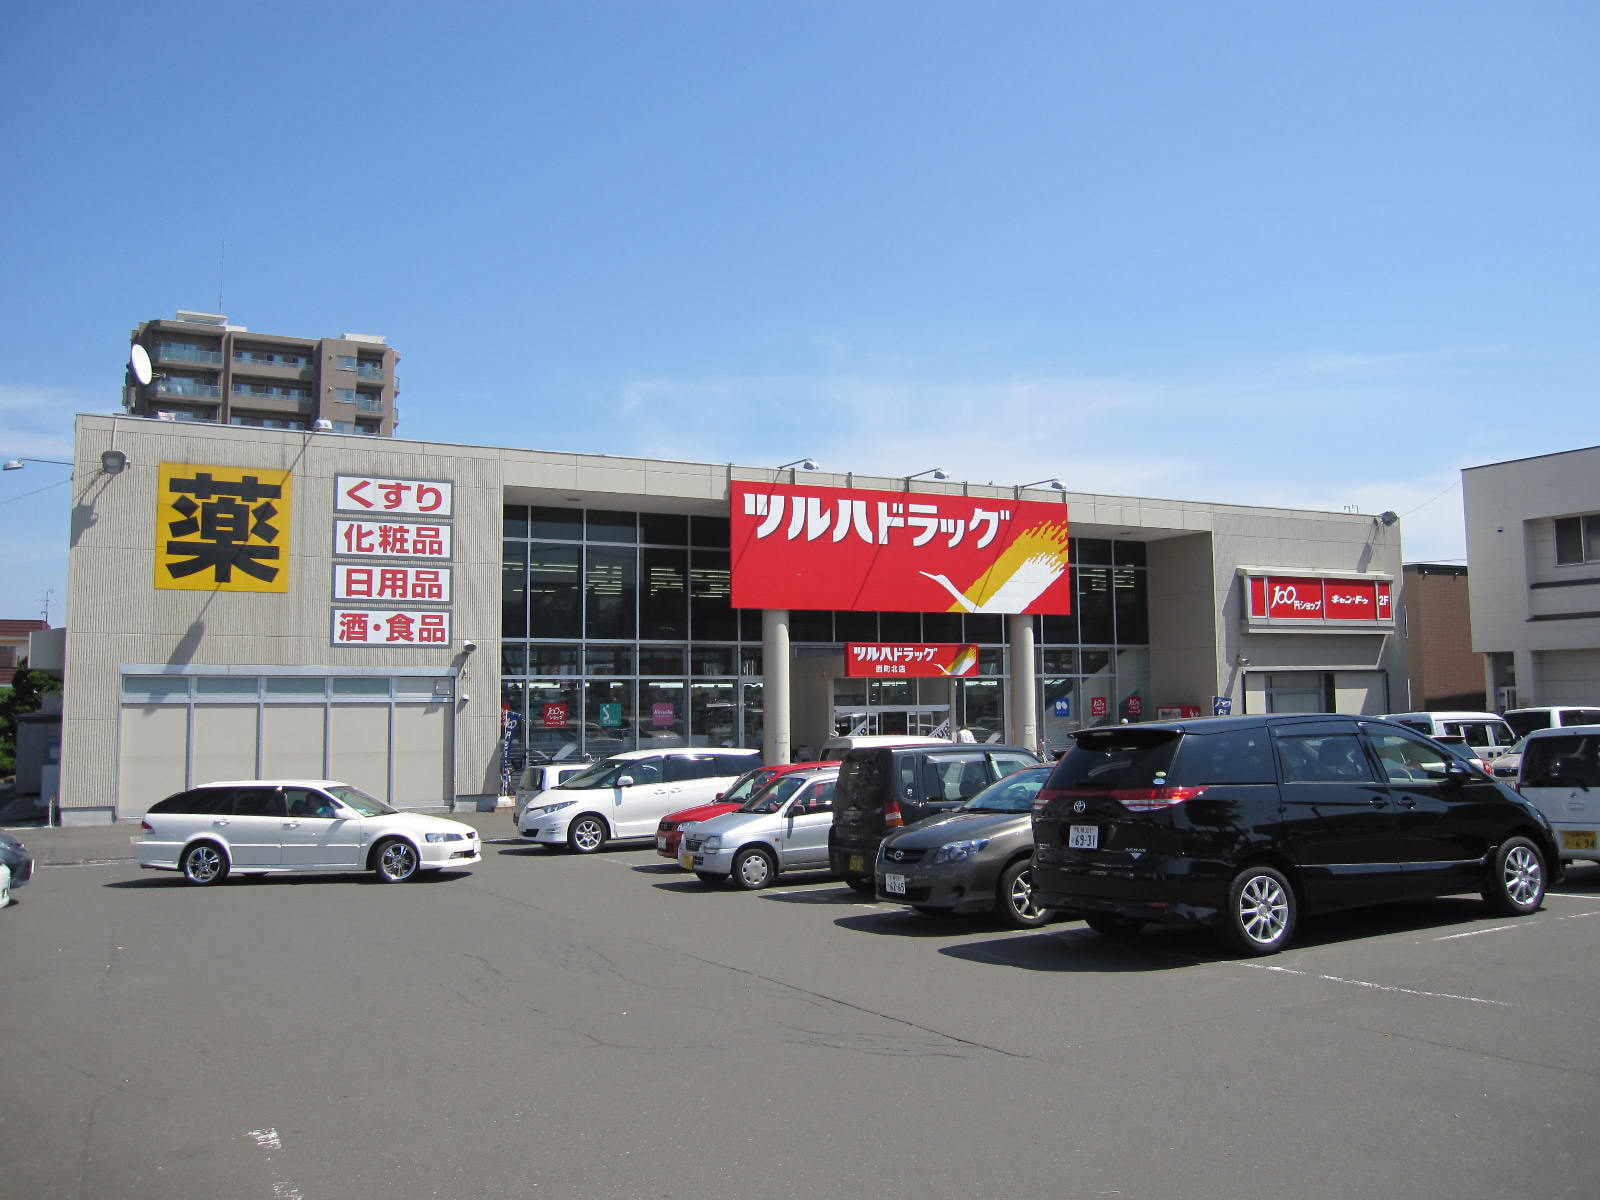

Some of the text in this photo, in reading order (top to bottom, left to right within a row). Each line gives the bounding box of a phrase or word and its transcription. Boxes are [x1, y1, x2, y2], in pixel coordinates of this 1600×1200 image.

[345, 480, 444, 512] くすり
[165, 472, 282, 583] 薬
[743, 493, 1011, 549] ツルハドラッグ
[344, 523, 444, 556] 化粧品
[344, 568, 444, 599] 日用品
[1378, 595, 1389, 606] 2F
[338, 612, 447, 643] 酒・食品
[853, 646, 938, 662] ツルハドラッグ
[875, 664, 906, 673] 西町北店
[1075, 834, 1095, 846] 69-31
